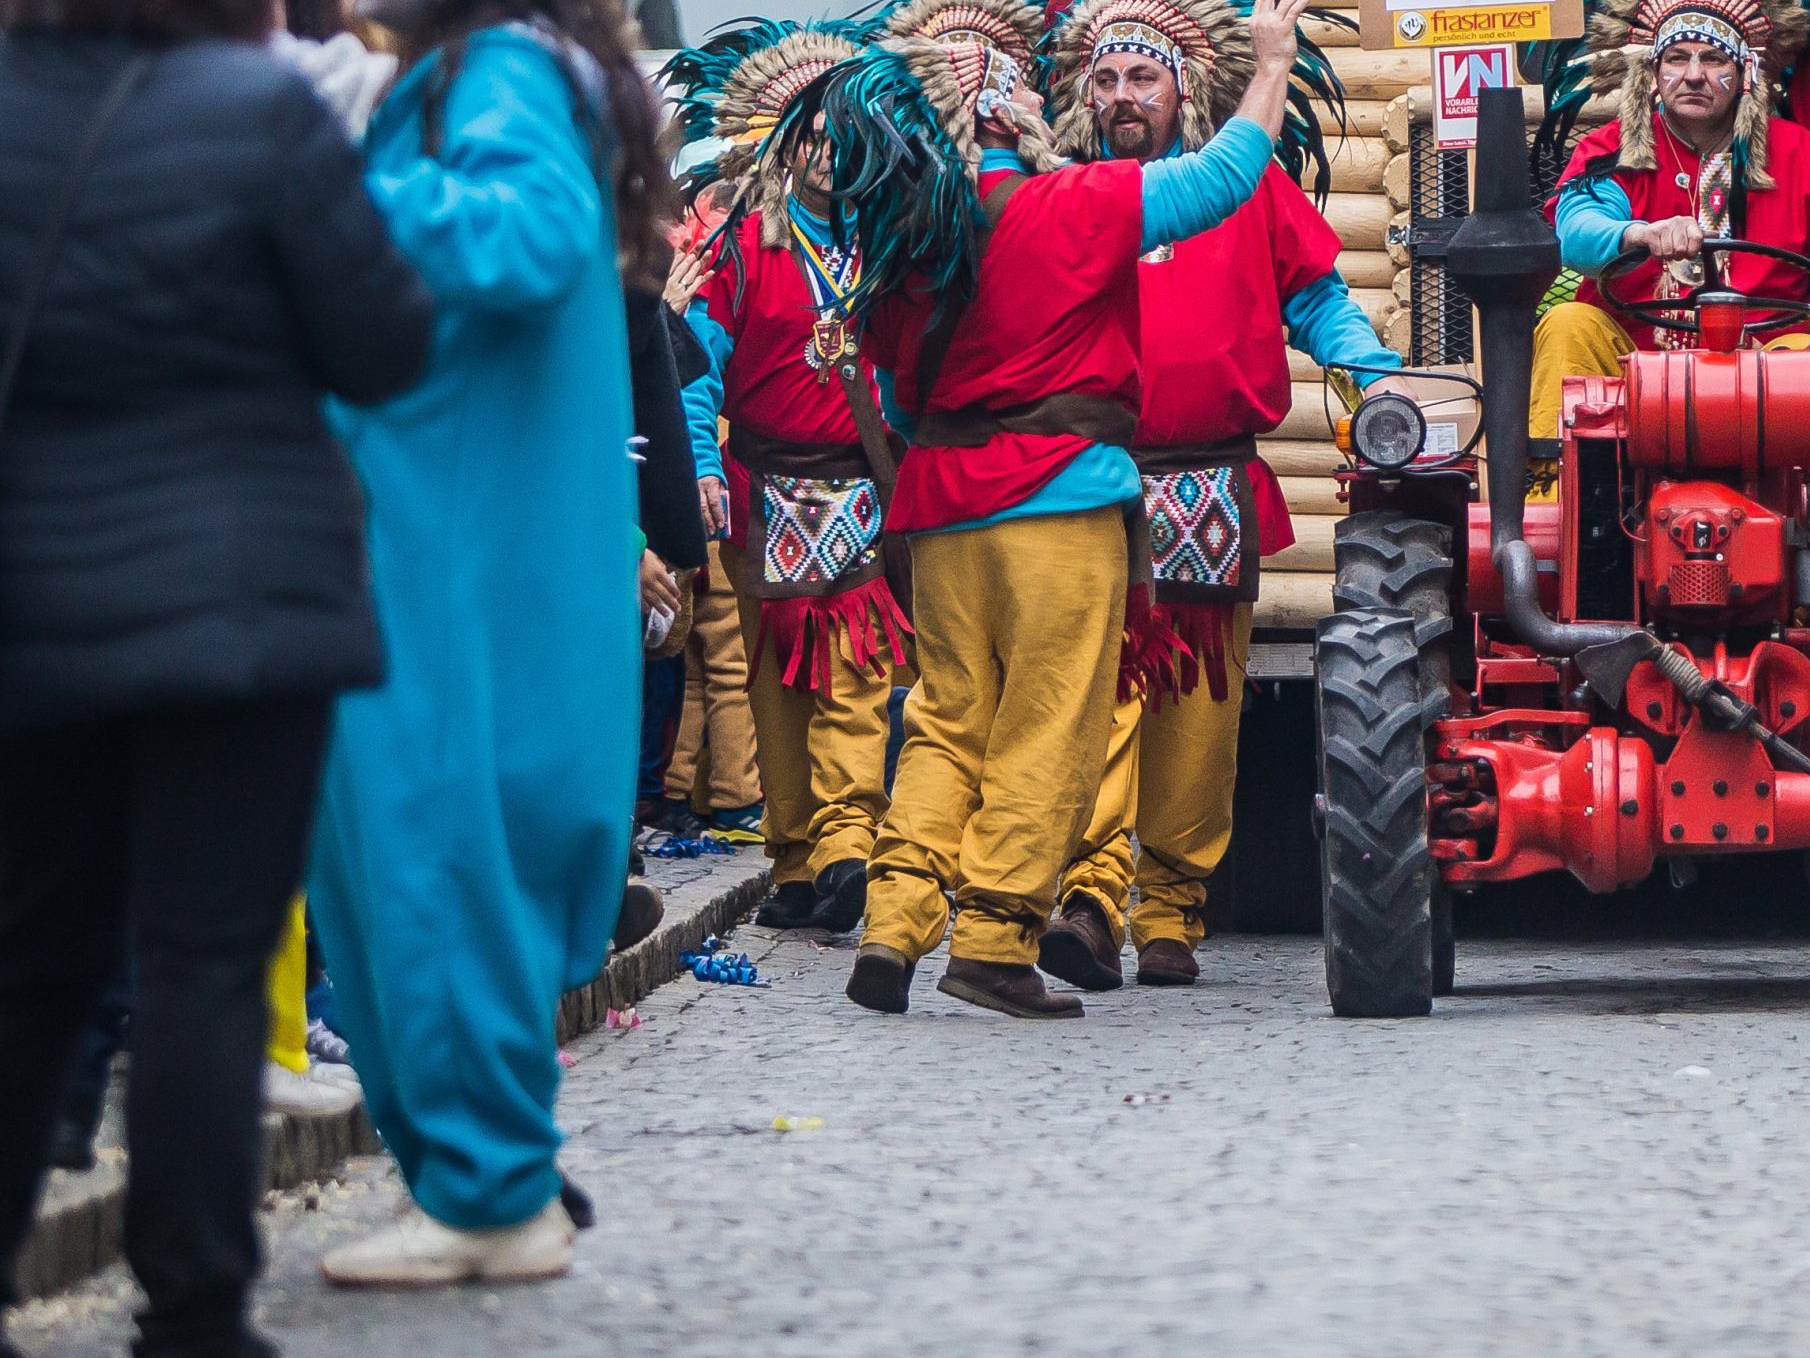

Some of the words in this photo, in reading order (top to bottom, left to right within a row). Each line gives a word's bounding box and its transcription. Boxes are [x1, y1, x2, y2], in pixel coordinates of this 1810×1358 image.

[1431, 9, 1542, 34] frastanzer
[1433, 31, 1477, 43] persönlich
[1479, 31, 1495, 40] und
[1497, 30, 1516, 39] echt
[1443, 52, 1504, 99] VN
